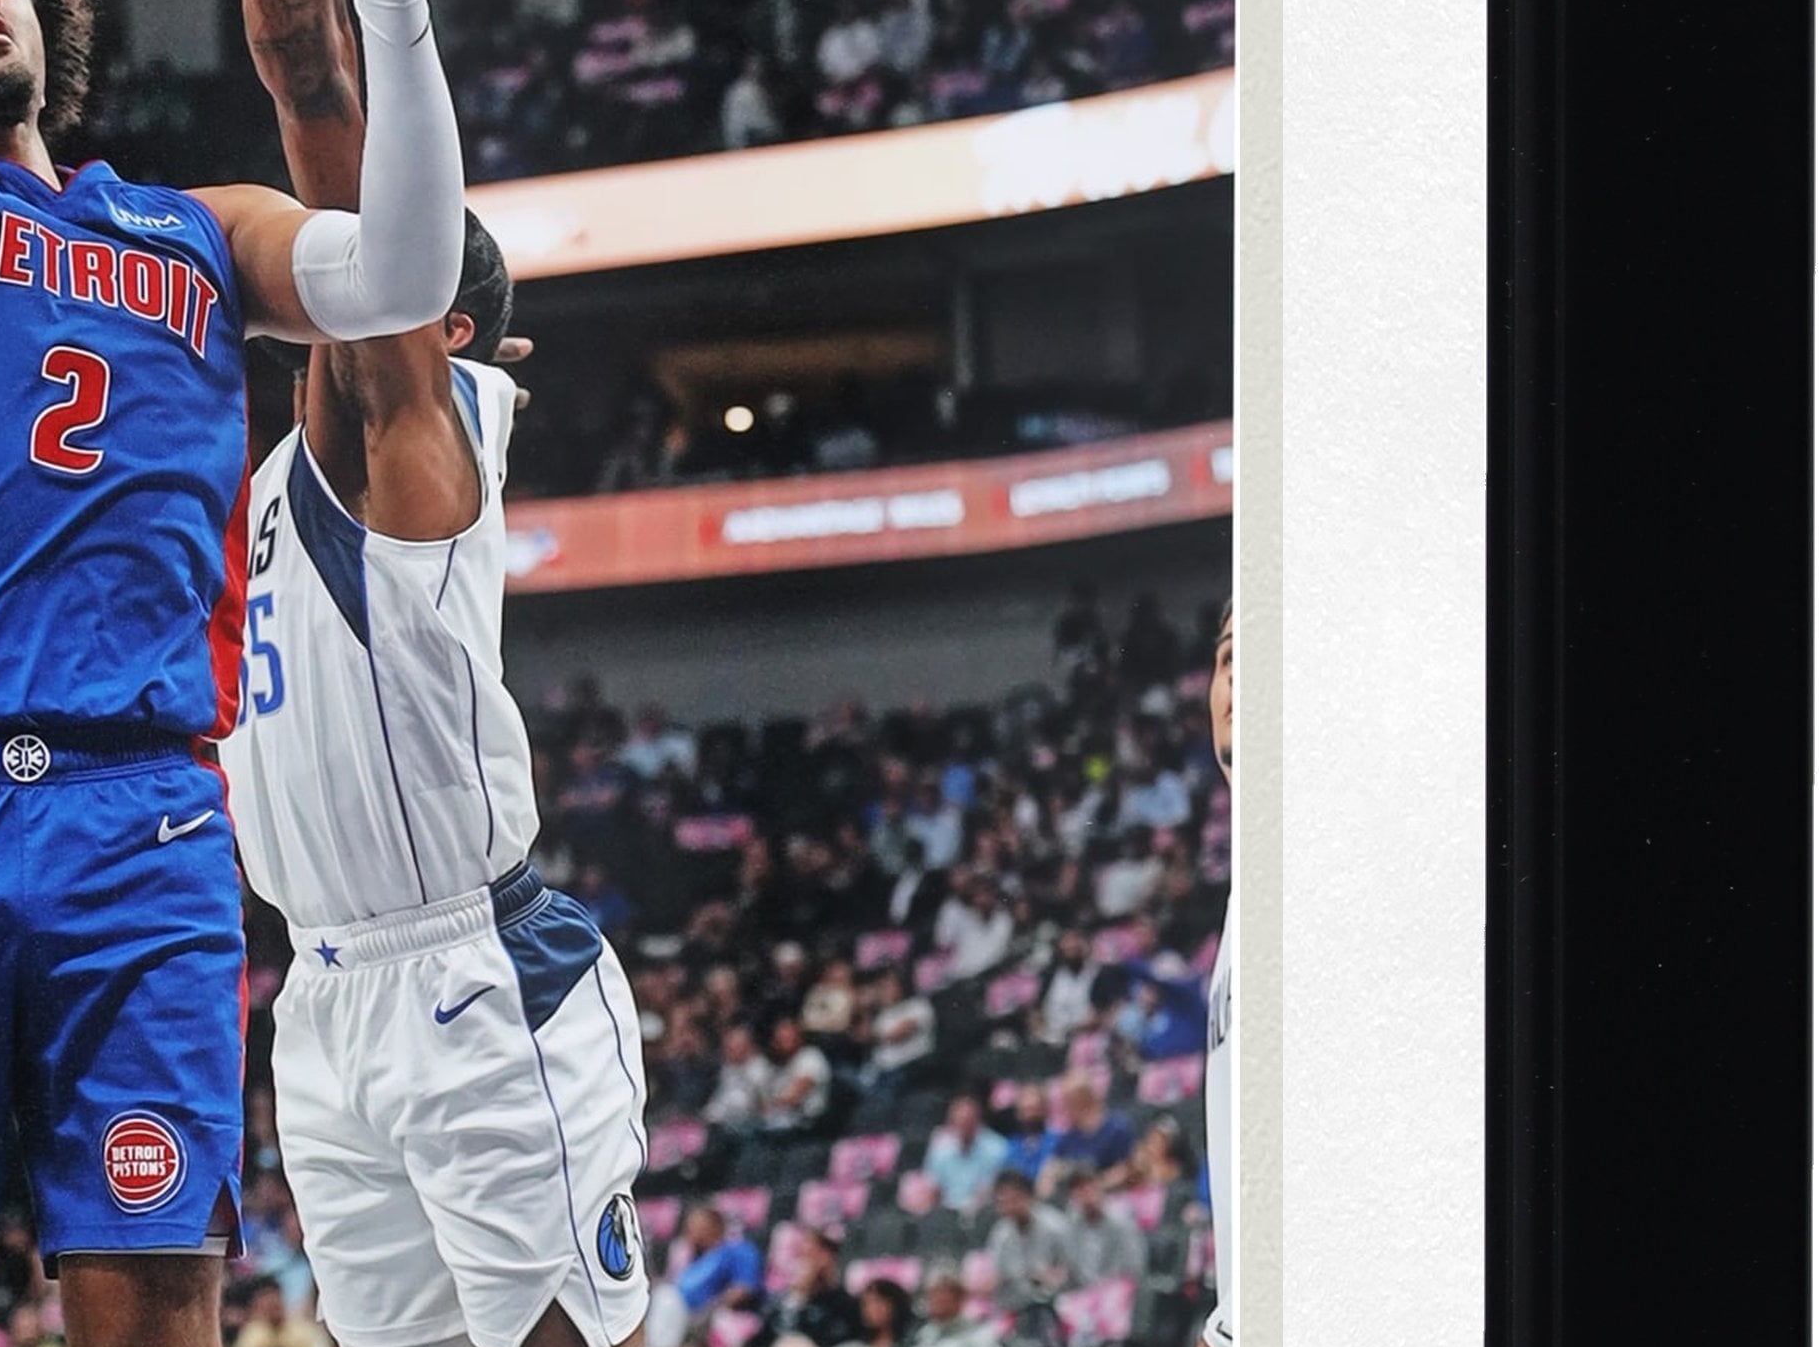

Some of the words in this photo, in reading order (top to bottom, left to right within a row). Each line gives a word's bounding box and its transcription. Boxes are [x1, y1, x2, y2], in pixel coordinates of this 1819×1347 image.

[31, 345, 111, 475] 2
[111, 1145, 167, 1161] DETROIT
[112, 1161, 167, 1178] PISTONS
